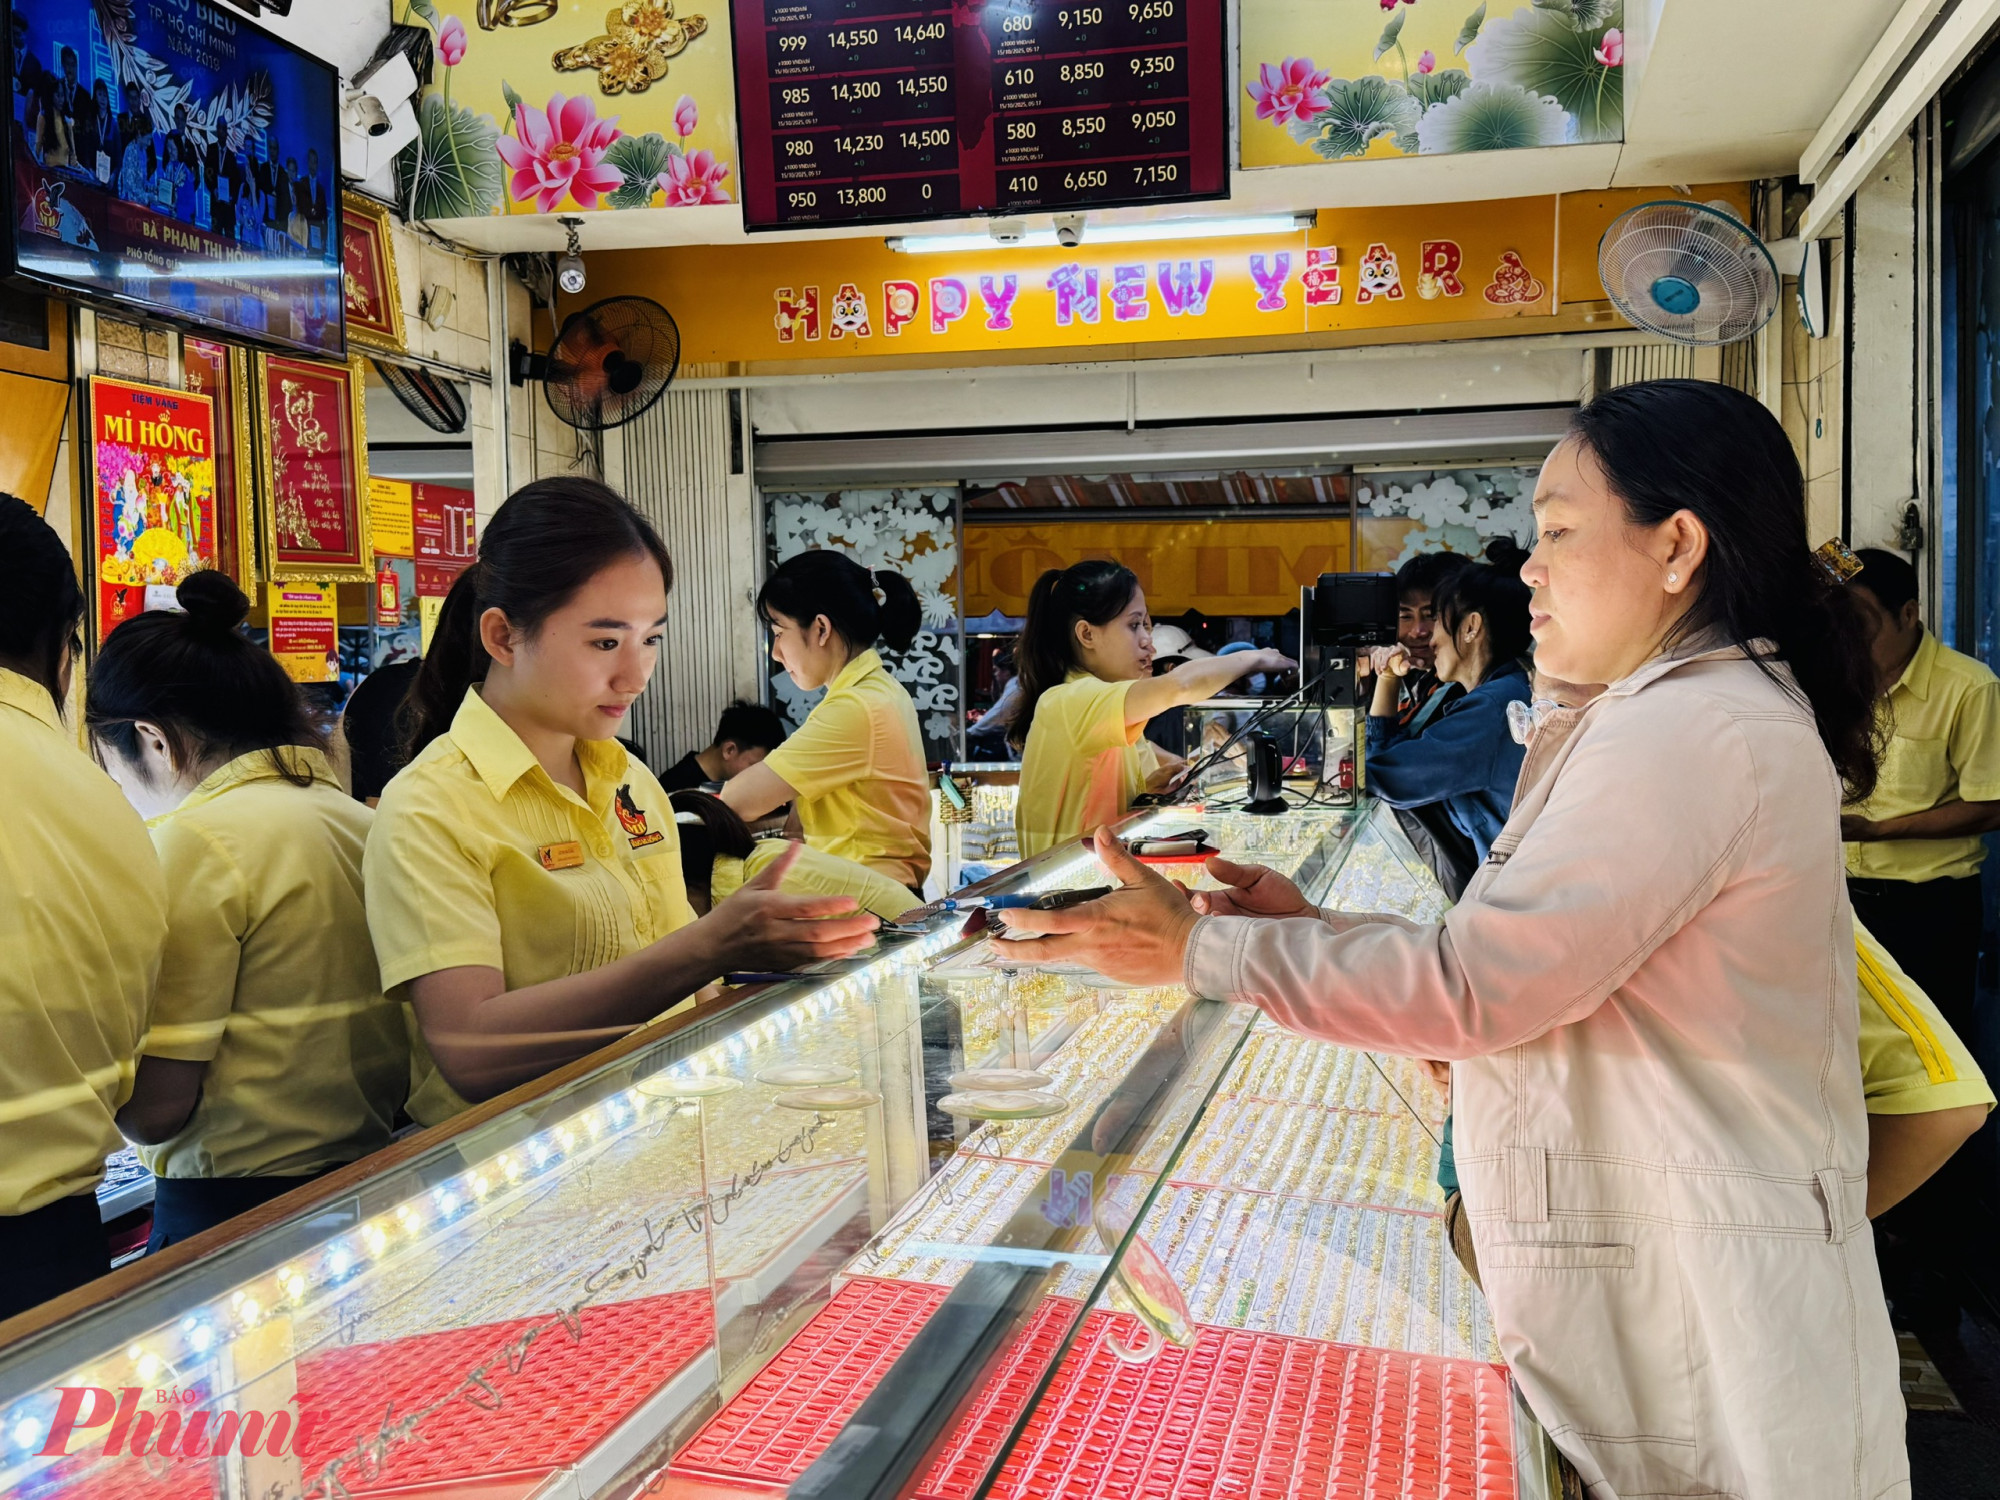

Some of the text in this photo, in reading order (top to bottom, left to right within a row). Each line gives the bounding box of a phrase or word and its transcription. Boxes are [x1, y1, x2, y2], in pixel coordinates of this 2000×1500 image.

[1003, 1, 1173, 32] 680 9,150 9,650
[209, 34, 236, 59] MINH
[779, 23, 945, 52] 999 14,550 14,640
[1005, 56, 1175, 86] 610 8,850 9,350
[782, 76, 947, 104] 985 14,300 14,550
[1008, 111, 1176, 140] 580 8,550 9,050
[786, 129, 950, 156] 980 14,230 14,500
[1009, 164, 1177, 192] 410 6,650 7,150
[789, 184, 932, 207] 950 13,800 0
[142, 220, 158, 240] BÀ
[164, 226, 200, 254] PHẠM
[774, 238, 1464, 342] HAPPY NEW YEAR
[138, 409, 204, 454] HỒNG
